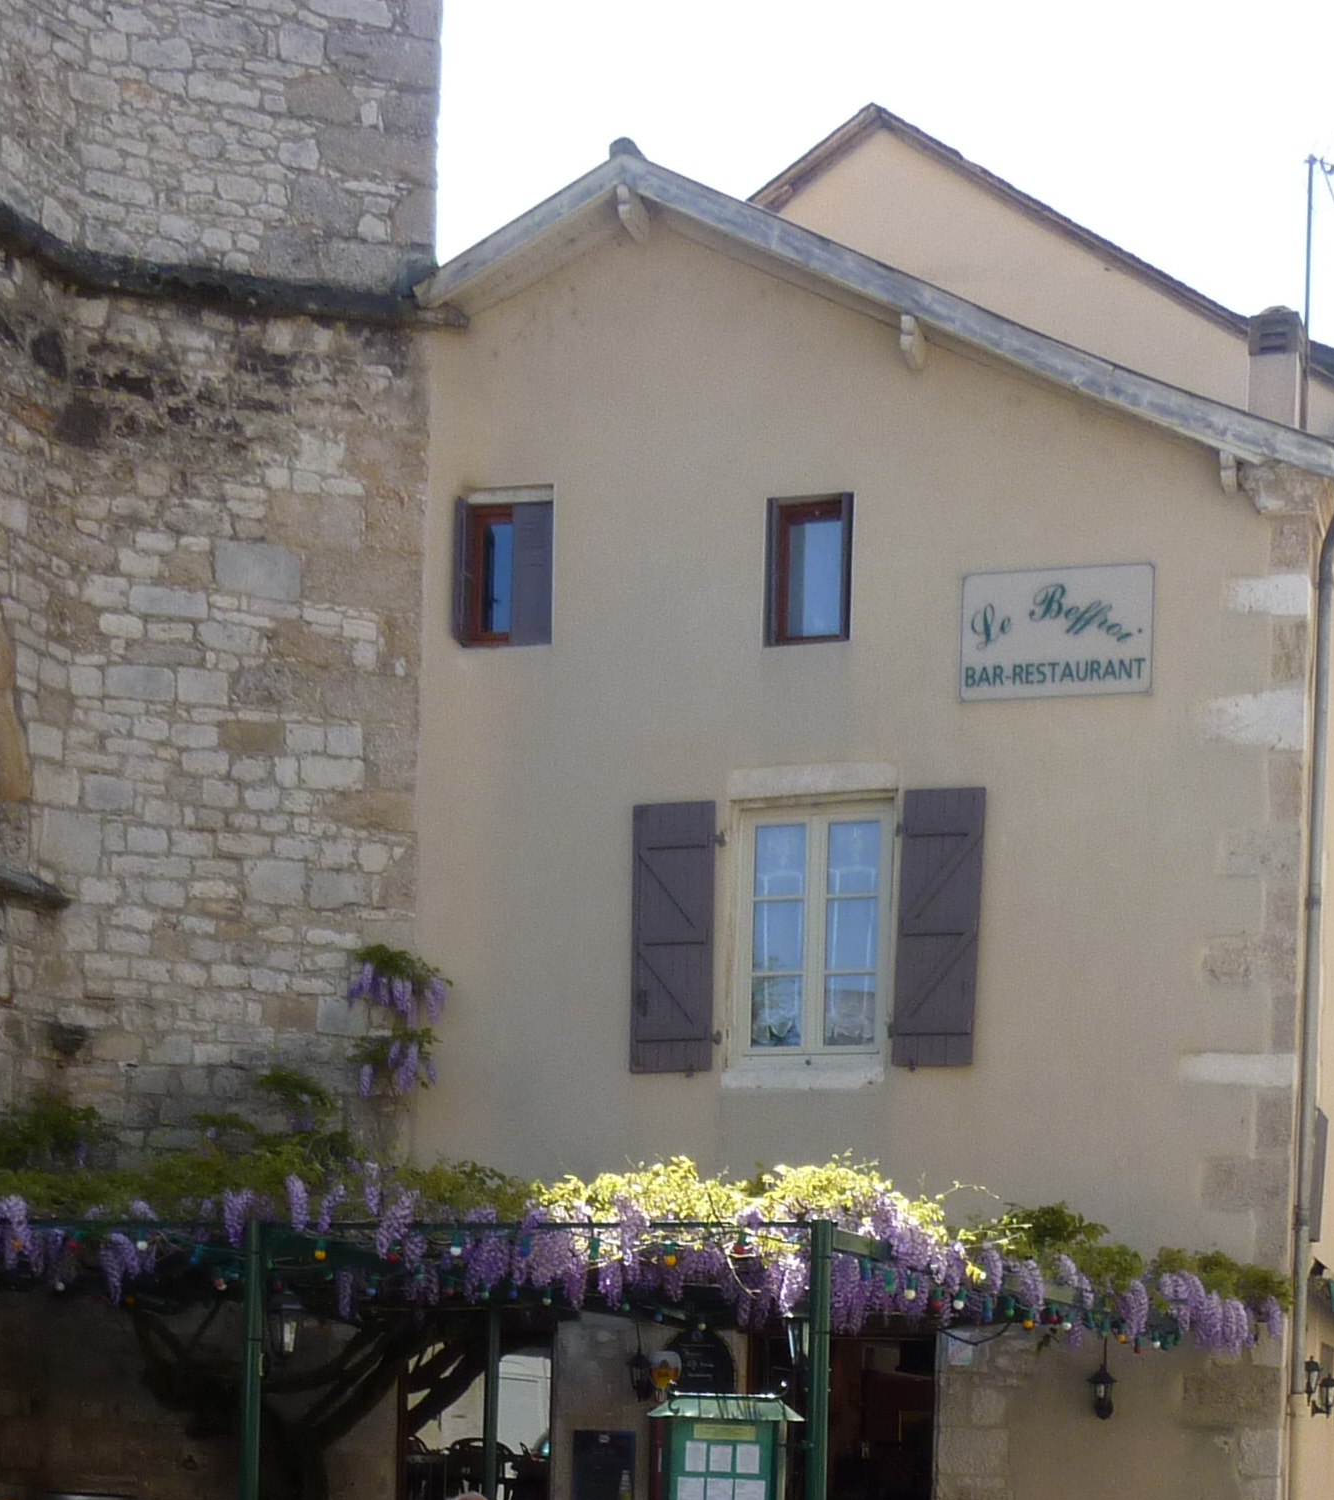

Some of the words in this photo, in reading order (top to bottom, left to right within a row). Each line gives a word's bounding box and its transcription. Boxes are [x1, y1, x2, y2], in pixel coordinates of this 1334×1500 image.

[971, 603, 1012, 650] Le
[1029, 583, 1143, 643] Beffroi
[965, 657, 1145, 688] BAR-RESTAURANT
